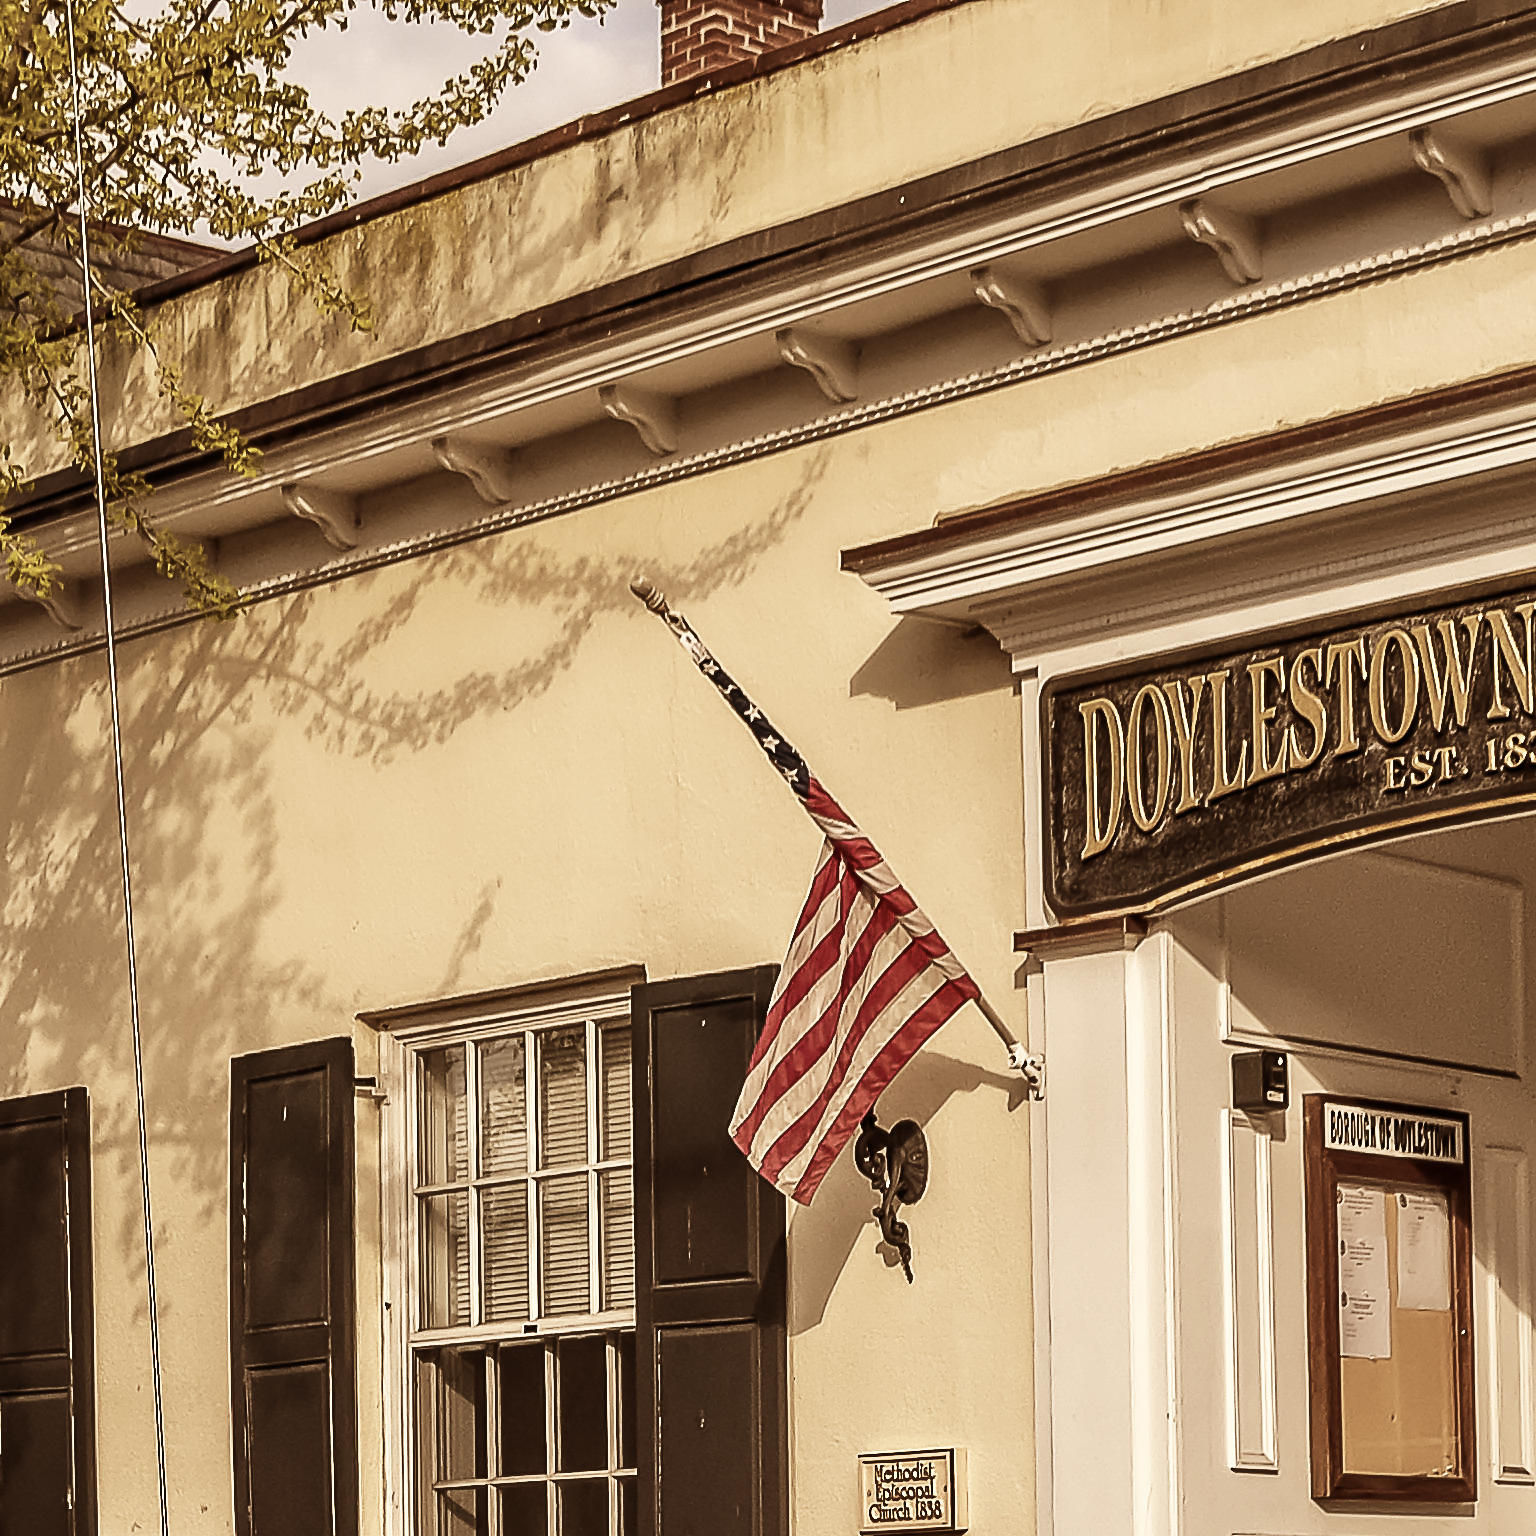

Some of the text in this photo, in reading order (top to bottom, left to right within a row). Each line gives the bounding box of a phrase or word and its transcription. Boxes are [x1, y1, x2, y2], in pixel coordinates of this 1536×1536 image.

[1381, 745, 1468, 794] EST.
[1330, 1109, 1457, 1160] BOROUGH OF DOYLESTOWN
[874, 1461, 937, 1484] Methodist
[875, 1478, 938, 1507] Episcopal
[868, 1500, 913, 1523] Church
